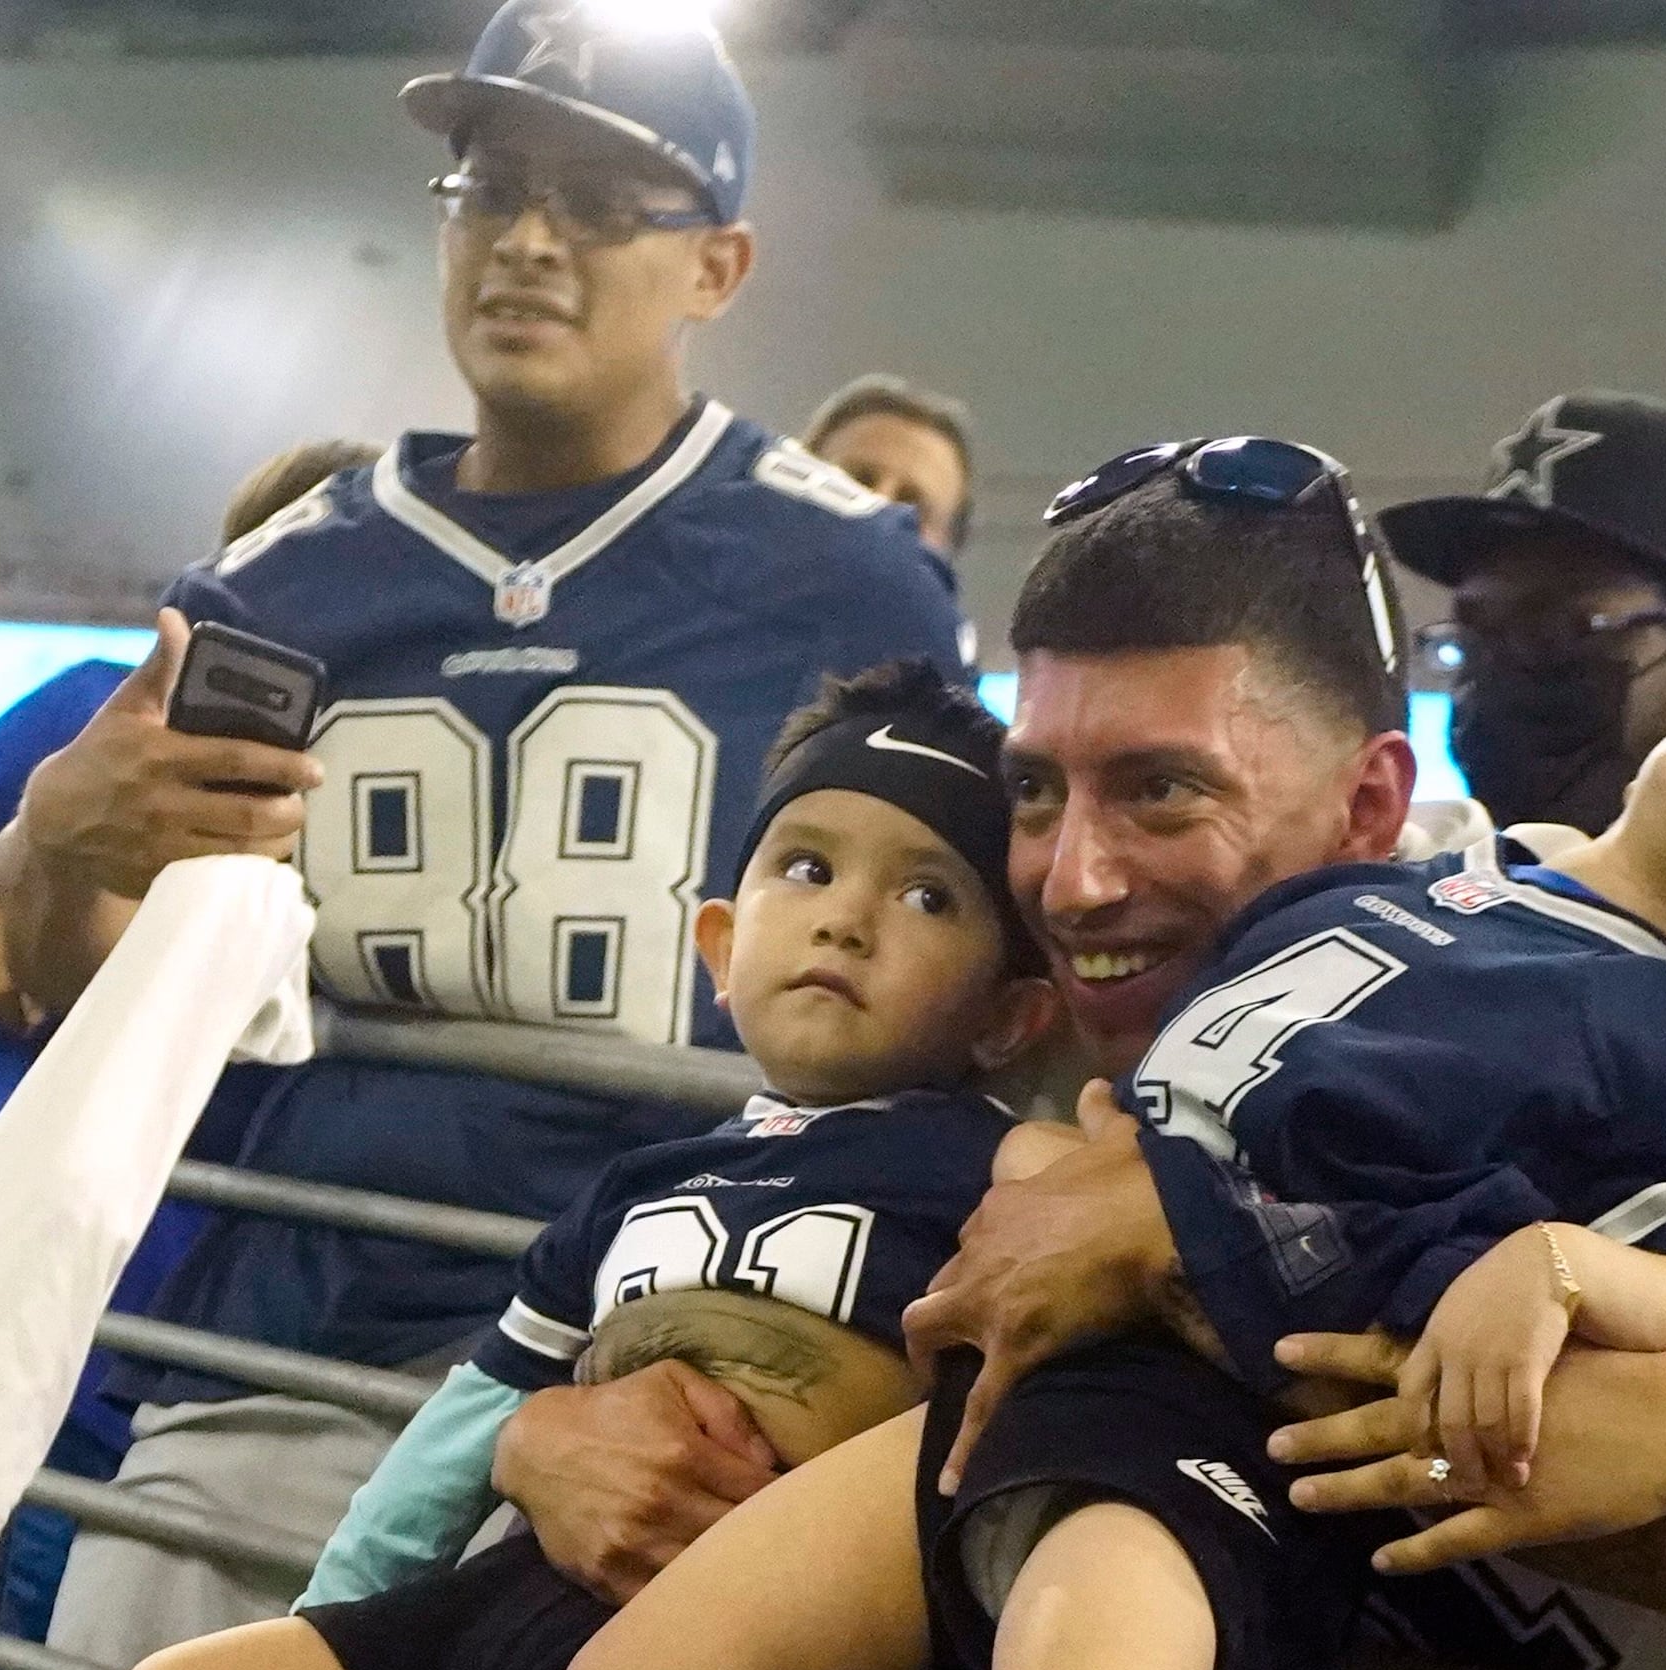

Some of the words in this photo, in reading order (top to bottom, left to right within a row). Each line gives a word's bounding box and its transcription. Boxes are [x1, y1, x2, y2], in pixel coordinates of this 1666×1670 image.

[295, 685, 719, 1047] 88
[1134, 926, 1410, 1164] 4
[1197, 1461, 1269, 1517] NIKE
